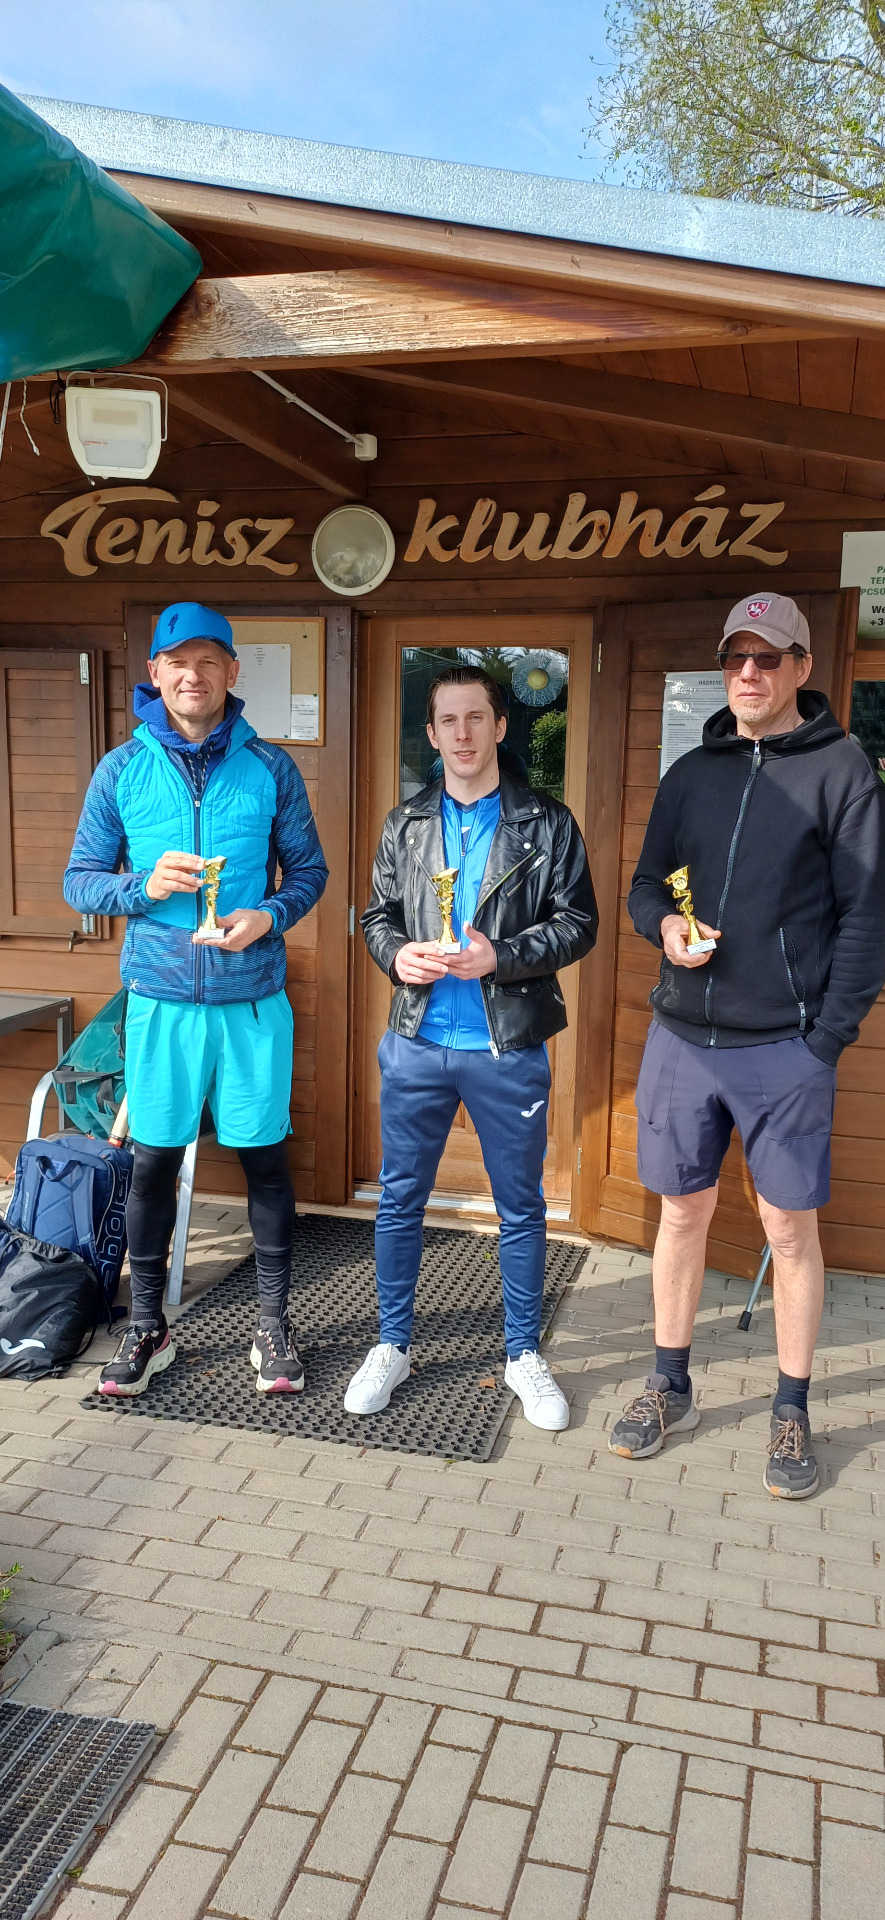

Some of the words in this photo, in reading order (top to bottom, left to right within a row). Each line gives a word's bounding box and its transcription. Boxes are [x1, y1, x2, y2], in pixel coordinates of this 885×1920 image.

[40, 486, 299, 577] Tenisz
[403, 484, 789, 567] klubház
[869, 617, 885, 627] +3
